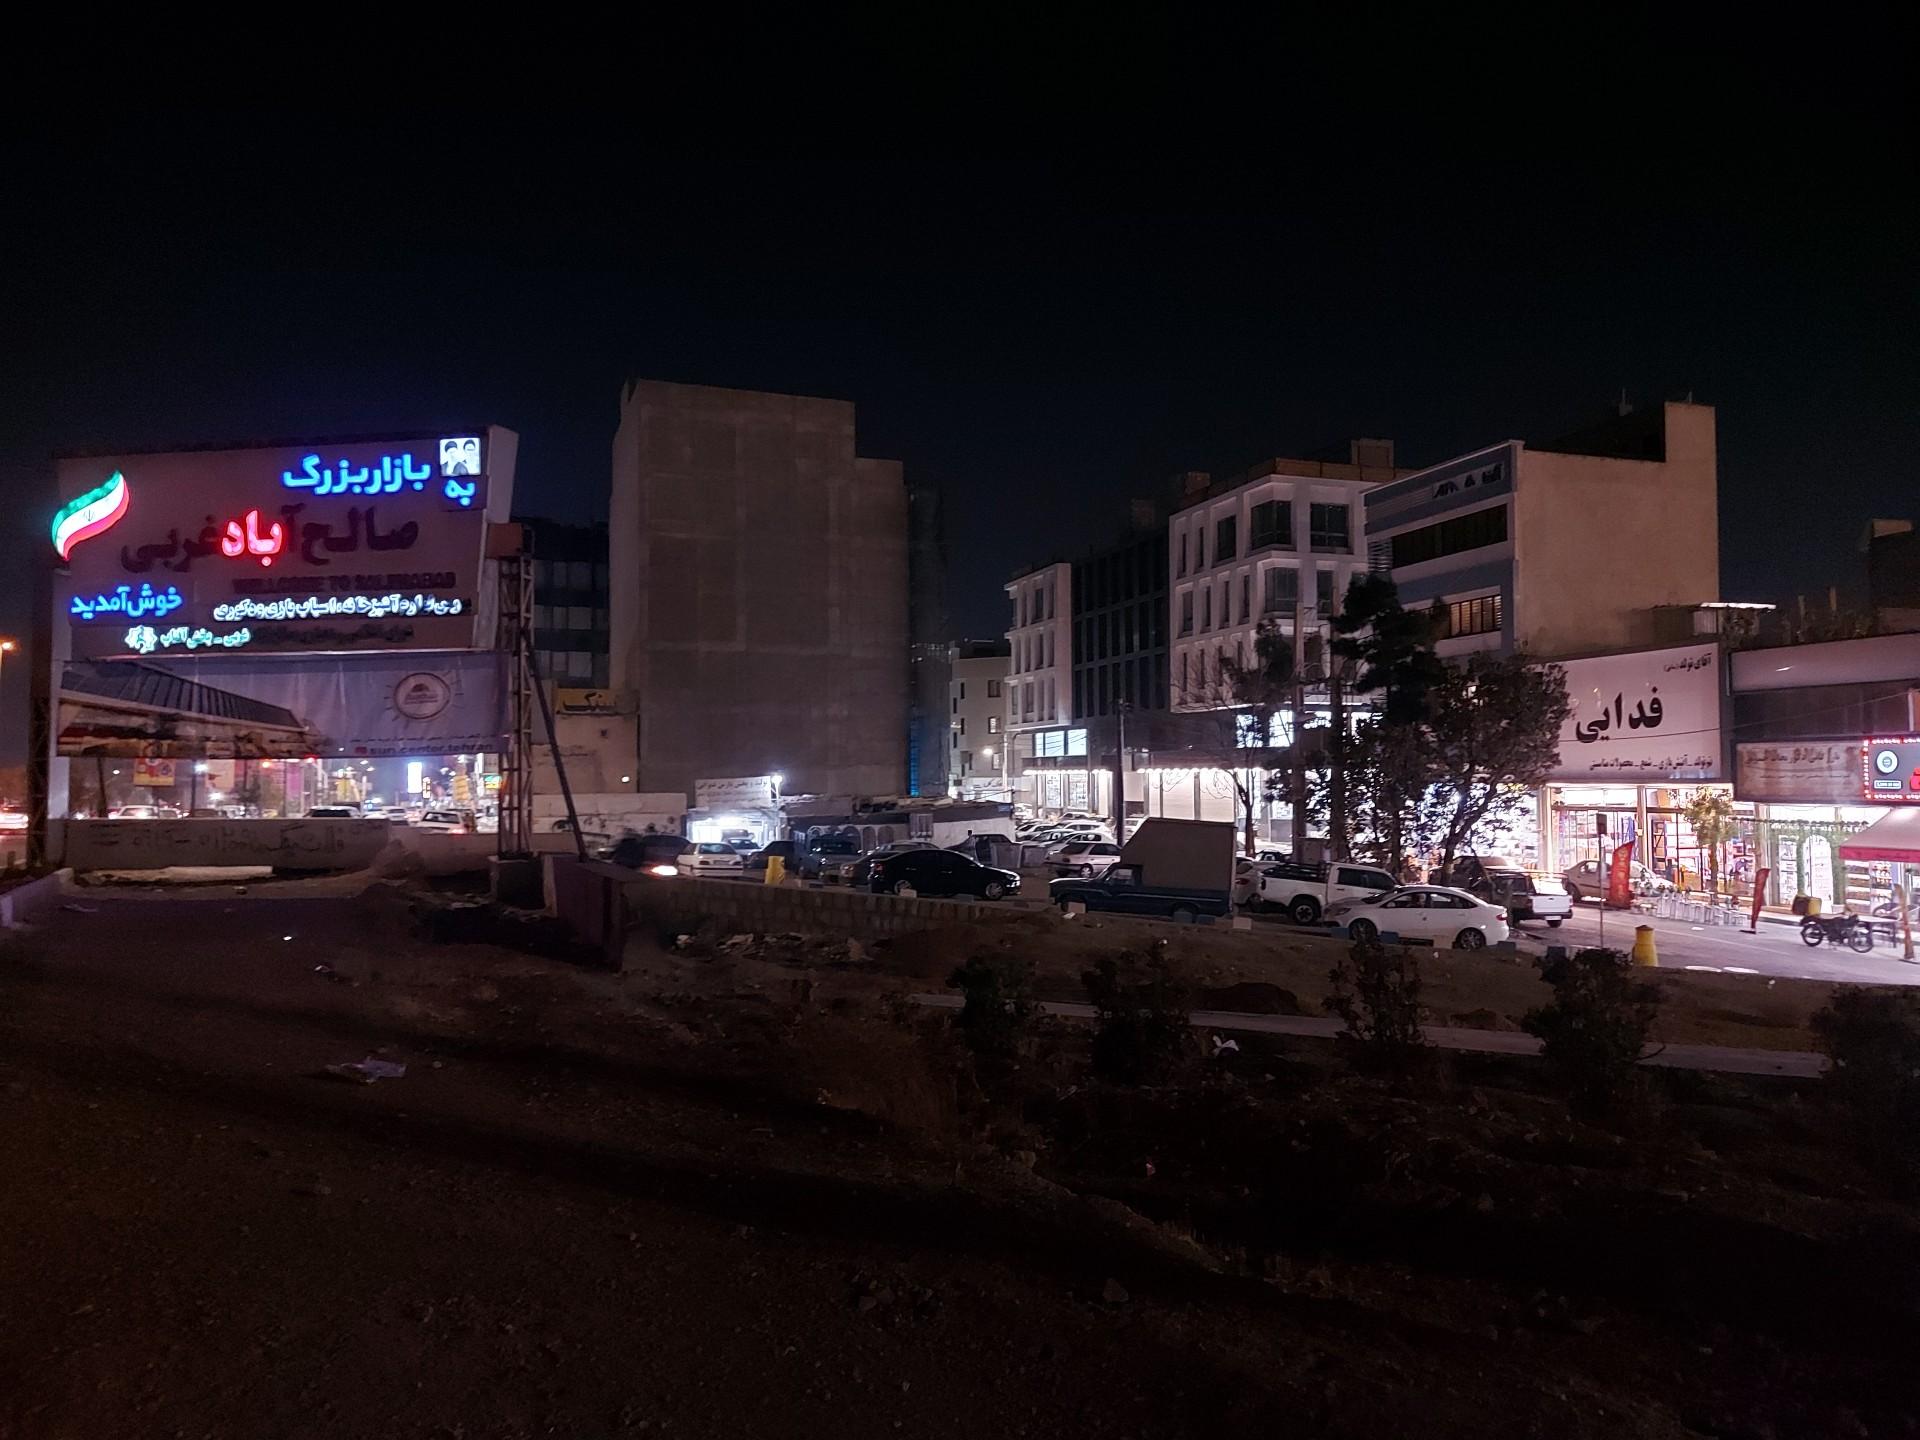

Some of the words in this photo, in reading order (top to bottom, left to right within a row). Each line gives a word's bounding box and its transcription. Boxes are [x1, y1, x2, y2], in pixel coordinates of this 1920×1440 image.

[283, 454, 369, 495] بزرگ
[364, 453, 432, 494] بازار
[445, 478, 476, 506] به
[71, 585, 131, 620] آمدید
[127, 583, 182, 617] خوش
[1576, 686, 1663, 743] فدایی
